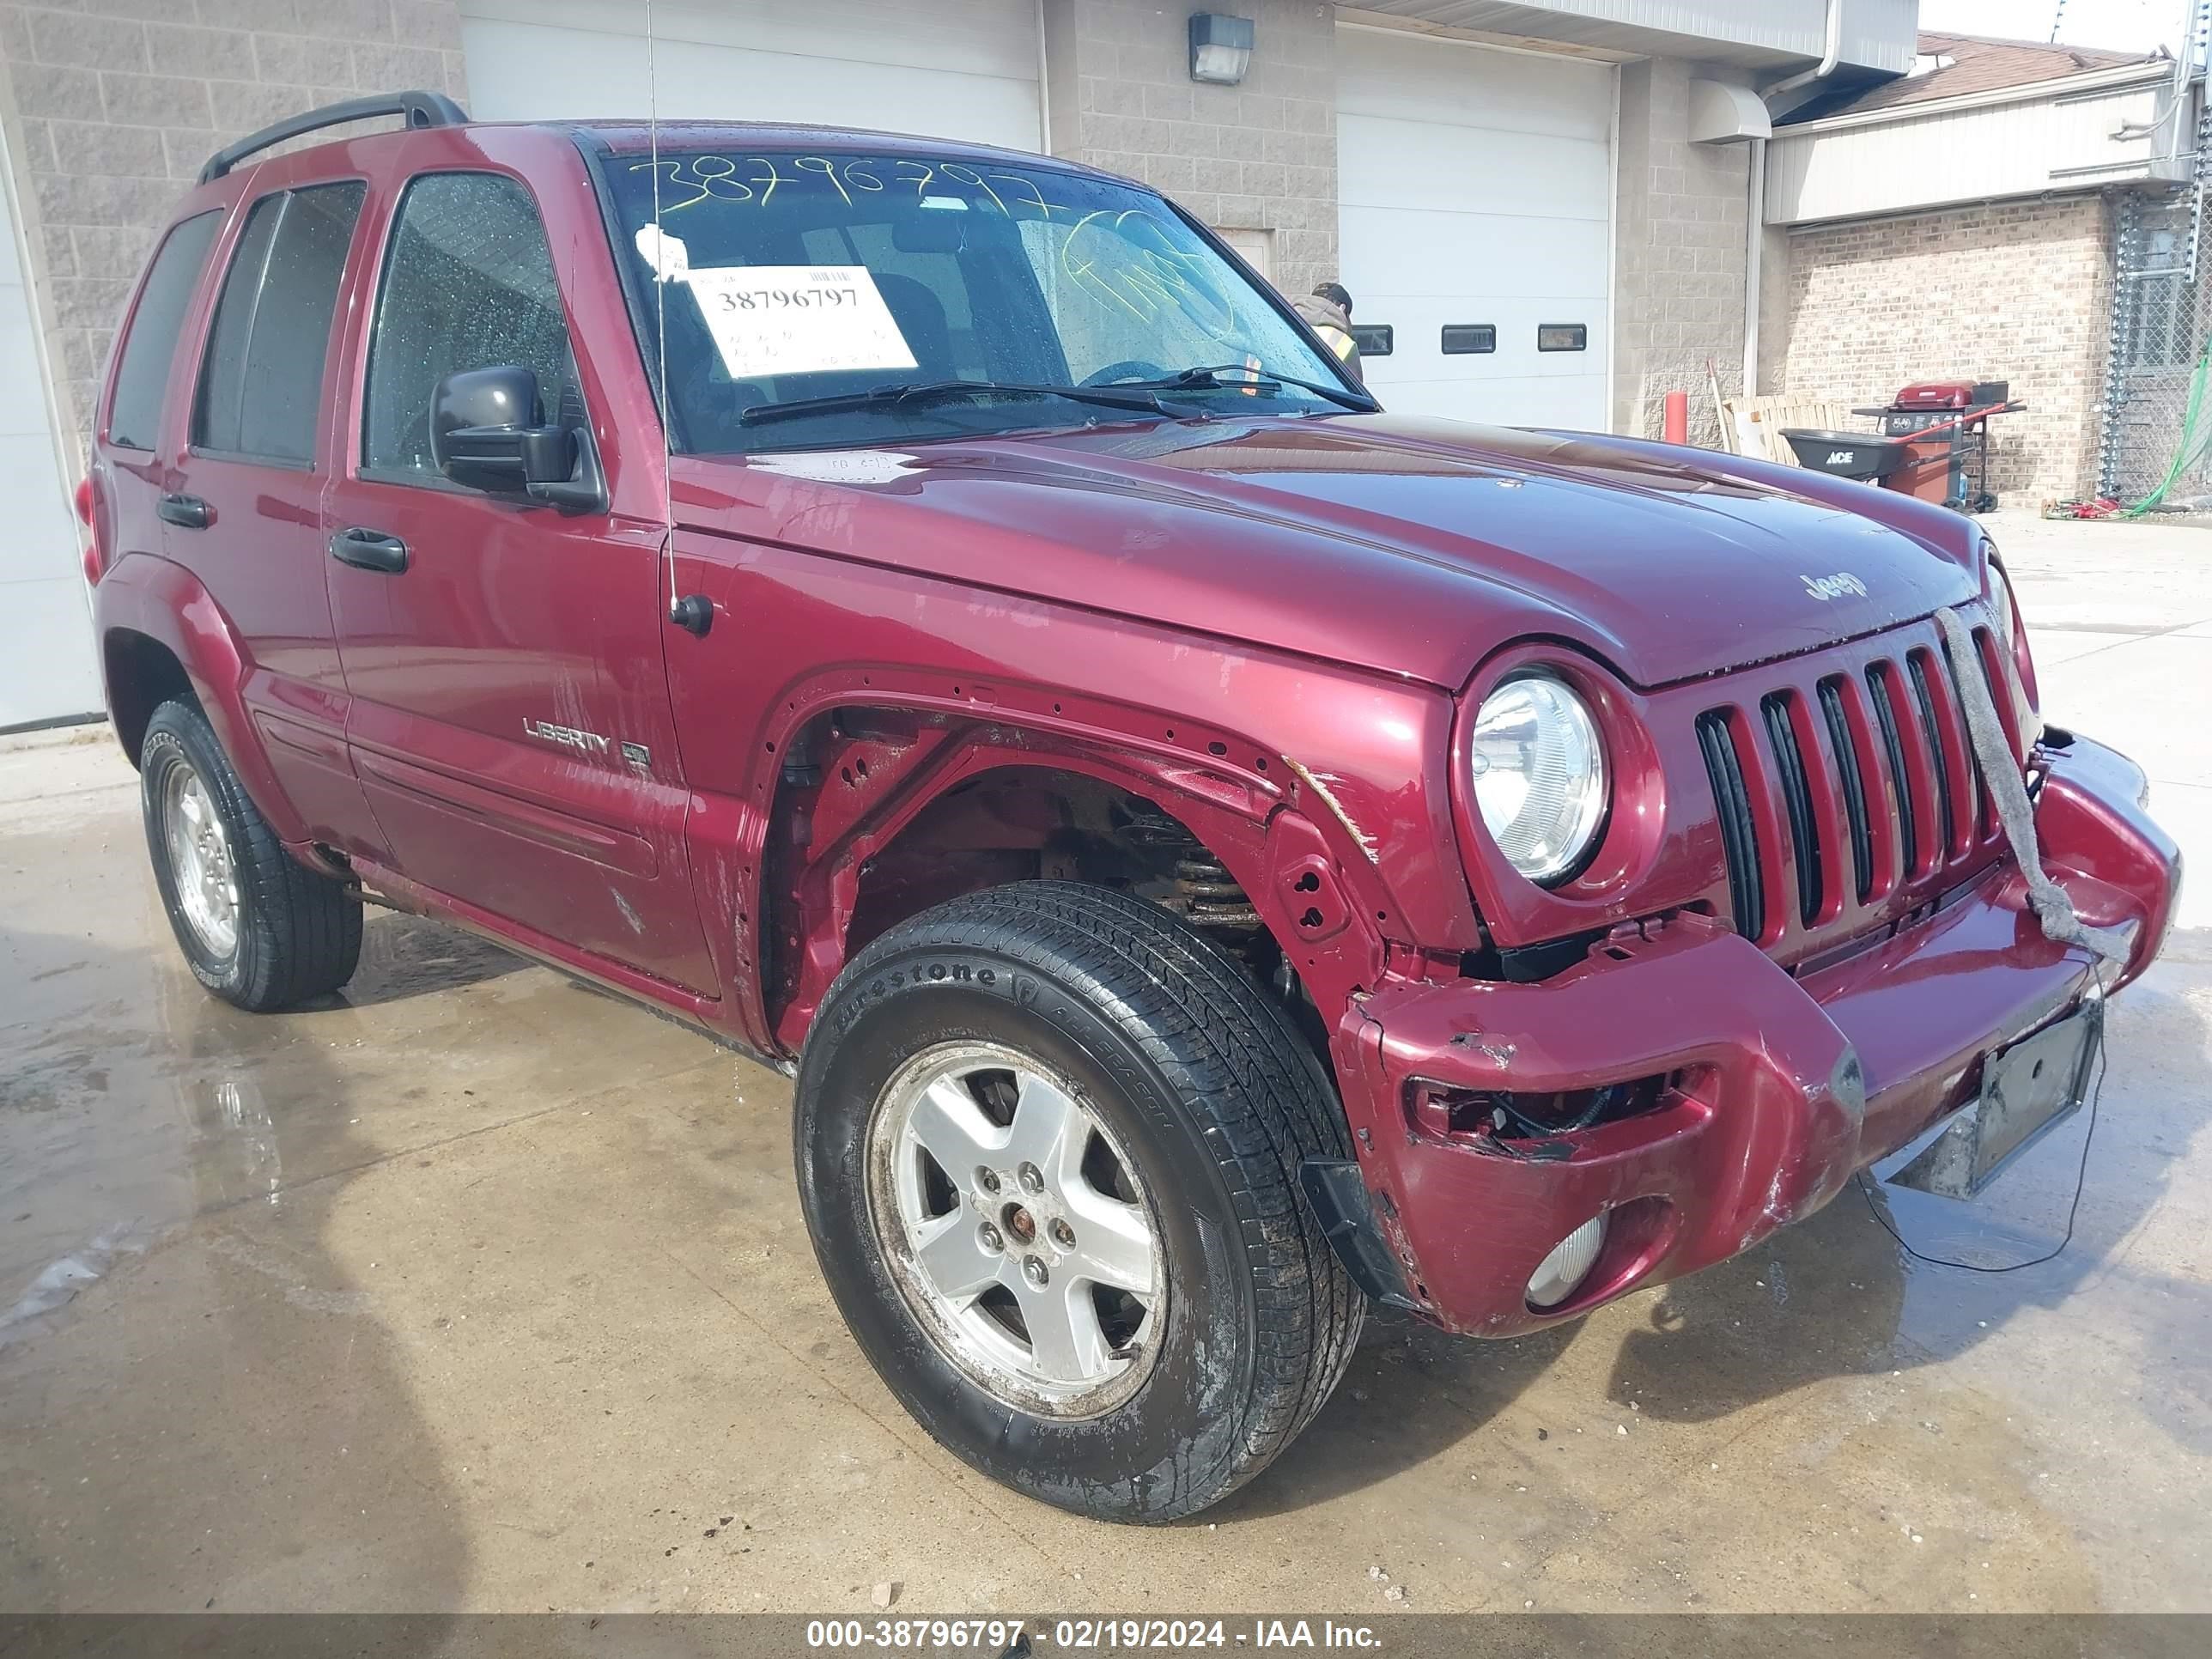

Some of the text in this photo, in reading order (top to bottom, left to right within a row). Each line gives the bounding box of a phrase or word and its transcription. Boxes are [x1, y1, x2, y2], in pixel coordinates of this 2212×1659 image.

[629, 156, 1071, 219] 38796797
[718, 288, 857, 313] 38796797
[1826, 451, 1854, 465] ACE
[1799, 572, 1868, 600] Jeep
[522, 717, 611, 754] LIBERTY
